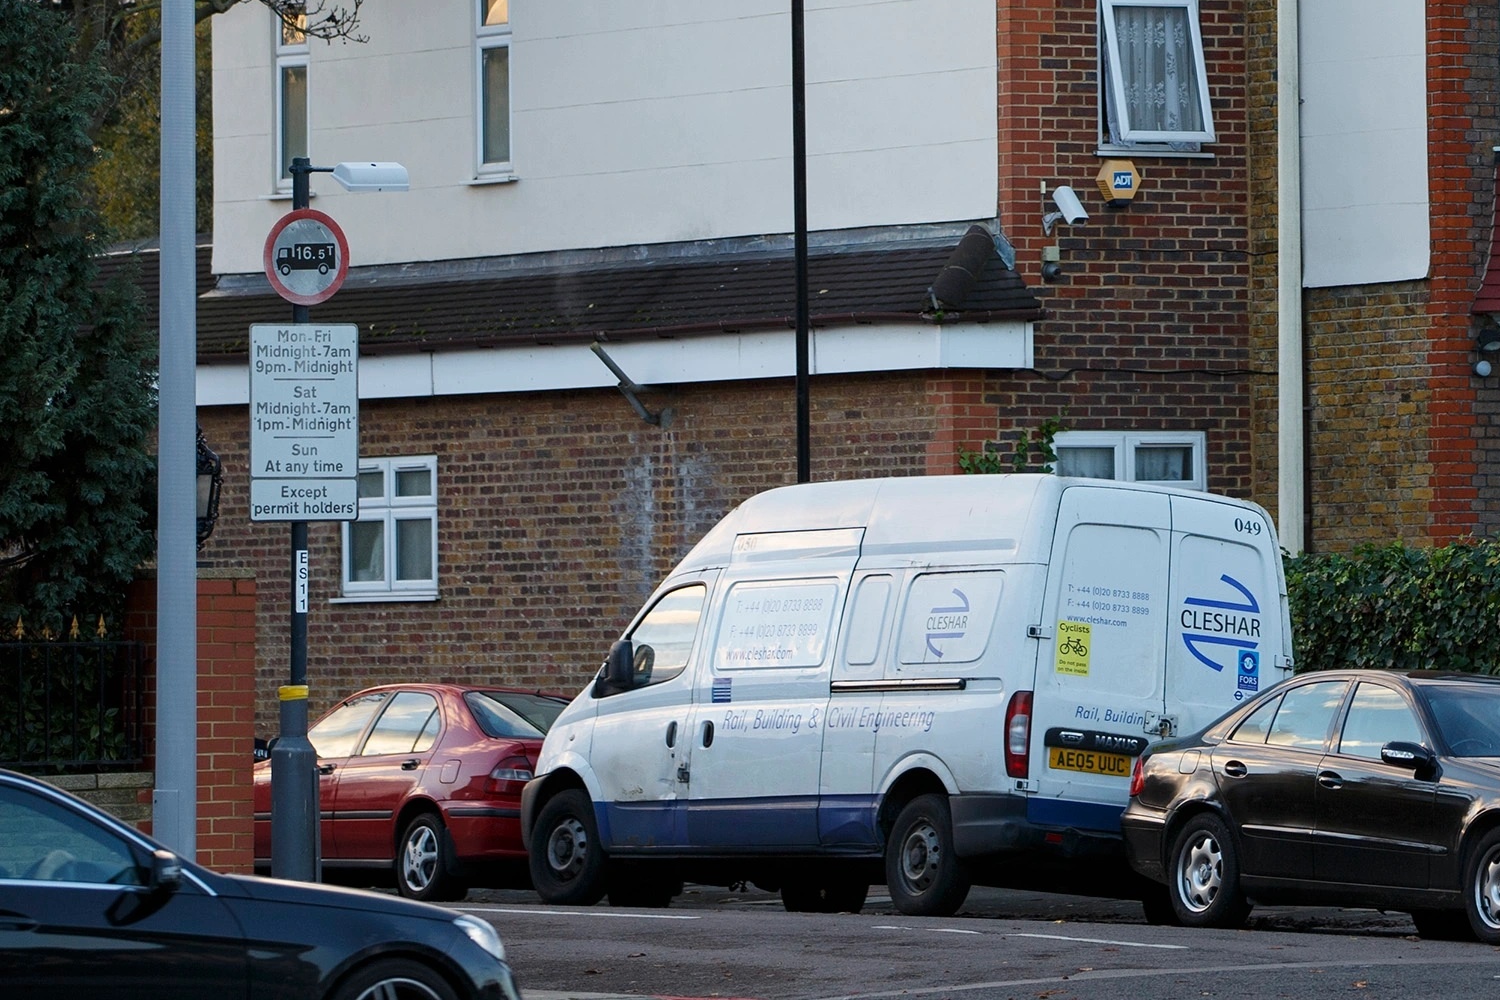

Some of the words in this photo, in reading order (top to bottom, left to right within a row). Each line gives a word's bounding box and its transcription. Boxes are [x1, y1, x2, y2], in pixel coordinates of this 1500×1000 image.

[1113, 175, 1133, 186] ADT
[293, 386, 317, 398] Sat
[291, 443, 318, 456] Sun
[265, 460, 281, 472] At
[285, 462, 309, 475] any
[313, 460, 343, 472] time
[281, 485, 328, 500] Except
[254, 502, 299, 516] permit
[303, 501, 354, 514] holders
[1234, 517, 1261, 536] 049
[1076, 586, 1090, 594] +44
[1092, 586, 1111, 596] (0)20
[1112, 588, 1130, 599] 8733
[1076, 600, 1090, 608] +44
[1092, 600, 1111, 611] (0)20
[1112, 603, 1130, 613] 8733
[926, 615, 968, 630] CLESHAR
[1059, 622, 1090, 634] Cyclists
[1066, 615, 1128, 627] www.cleshar.com
[1180, 609, 1261, 638] CLESHAR
[725, 646, 793, 661] www.cleshar.com
[1239, 675, 1257, 685] FORS
[721, 709, 748, 733] Rail,
[753, 708, 802, 734] Building
[808, 707, 819, 729] &
[828, 706, 857, 729] Civil
[858, 706, 935, 733] Engineering
[1075, 705, 1100, 722] Rail,
[1104, 708, 1144, 726] Buildin
[1095, 734, 1138, 751] MAXUS
[1056, 751, 1095, 769] AE05
[1097, 755, 1125, 773] UUC
